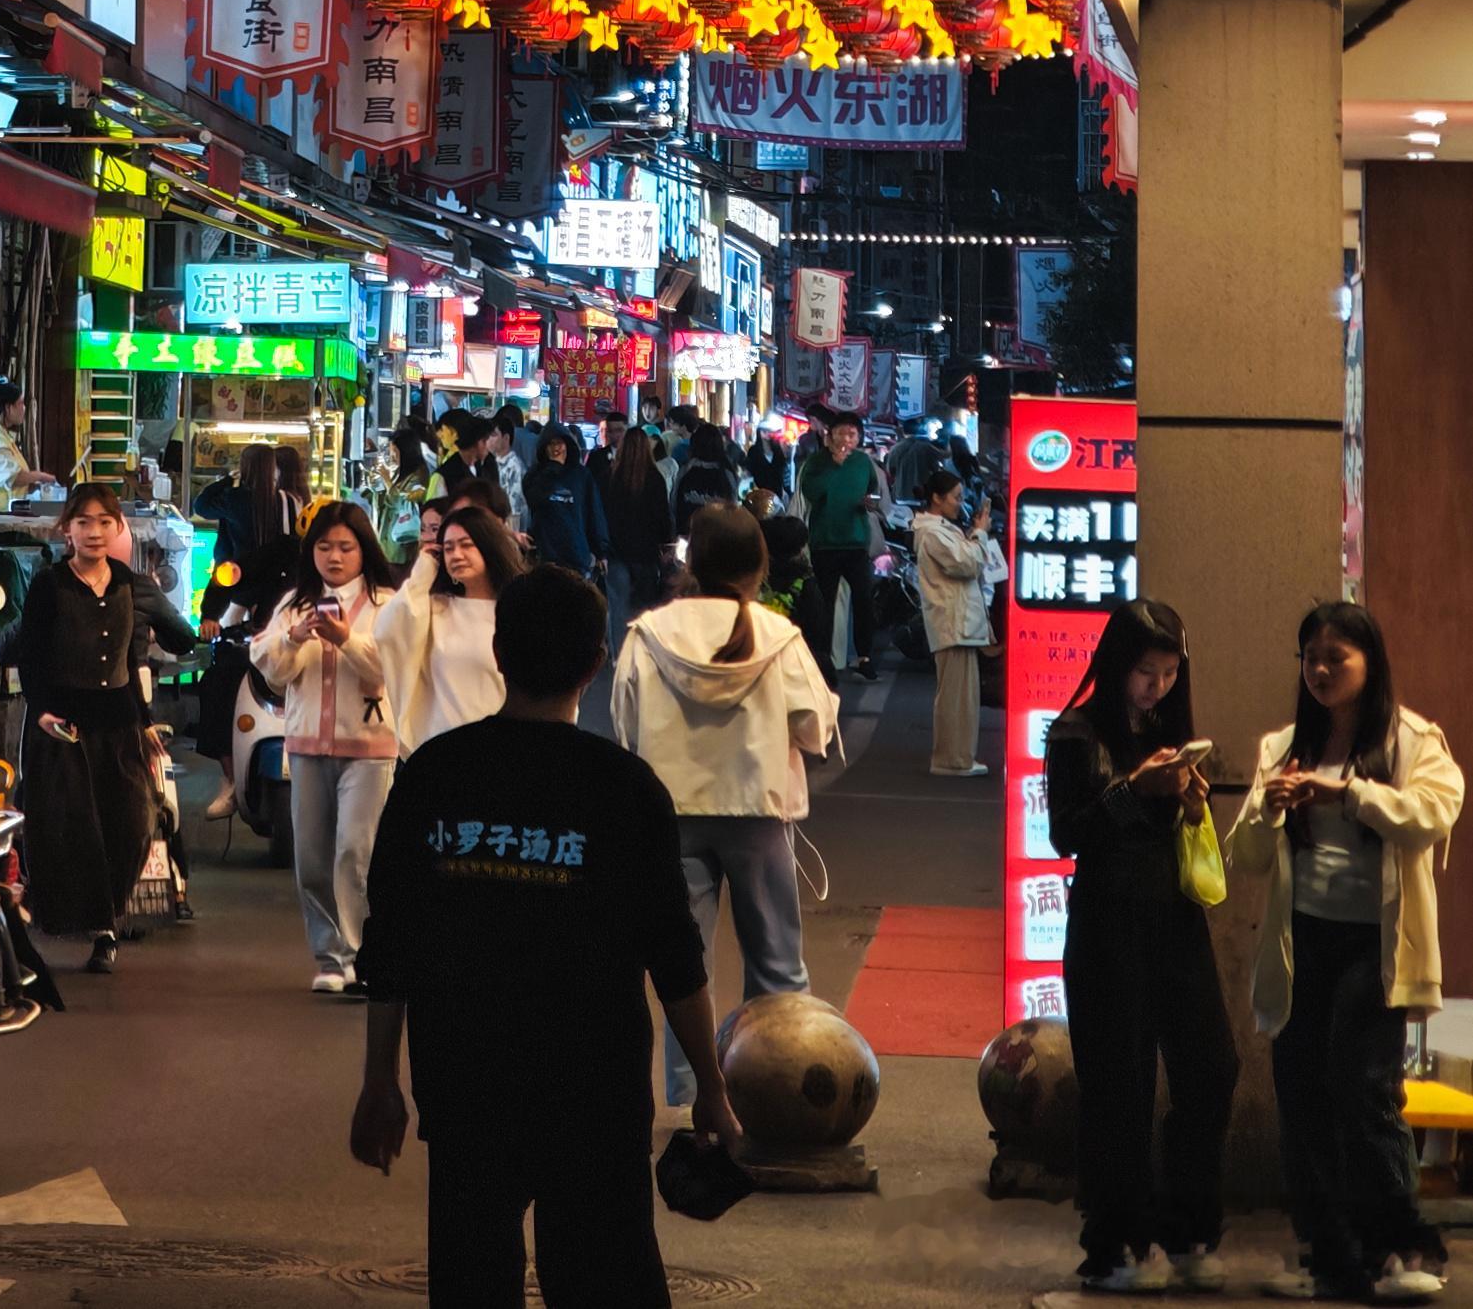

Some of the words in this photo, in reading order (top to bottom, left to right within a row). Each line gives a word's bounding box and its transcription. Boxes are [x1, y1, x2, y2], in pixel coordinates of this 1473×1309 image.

[709, 59, 949, 127] 烟火东湖
[193, 271, 343, 315] 凉拌青芒
